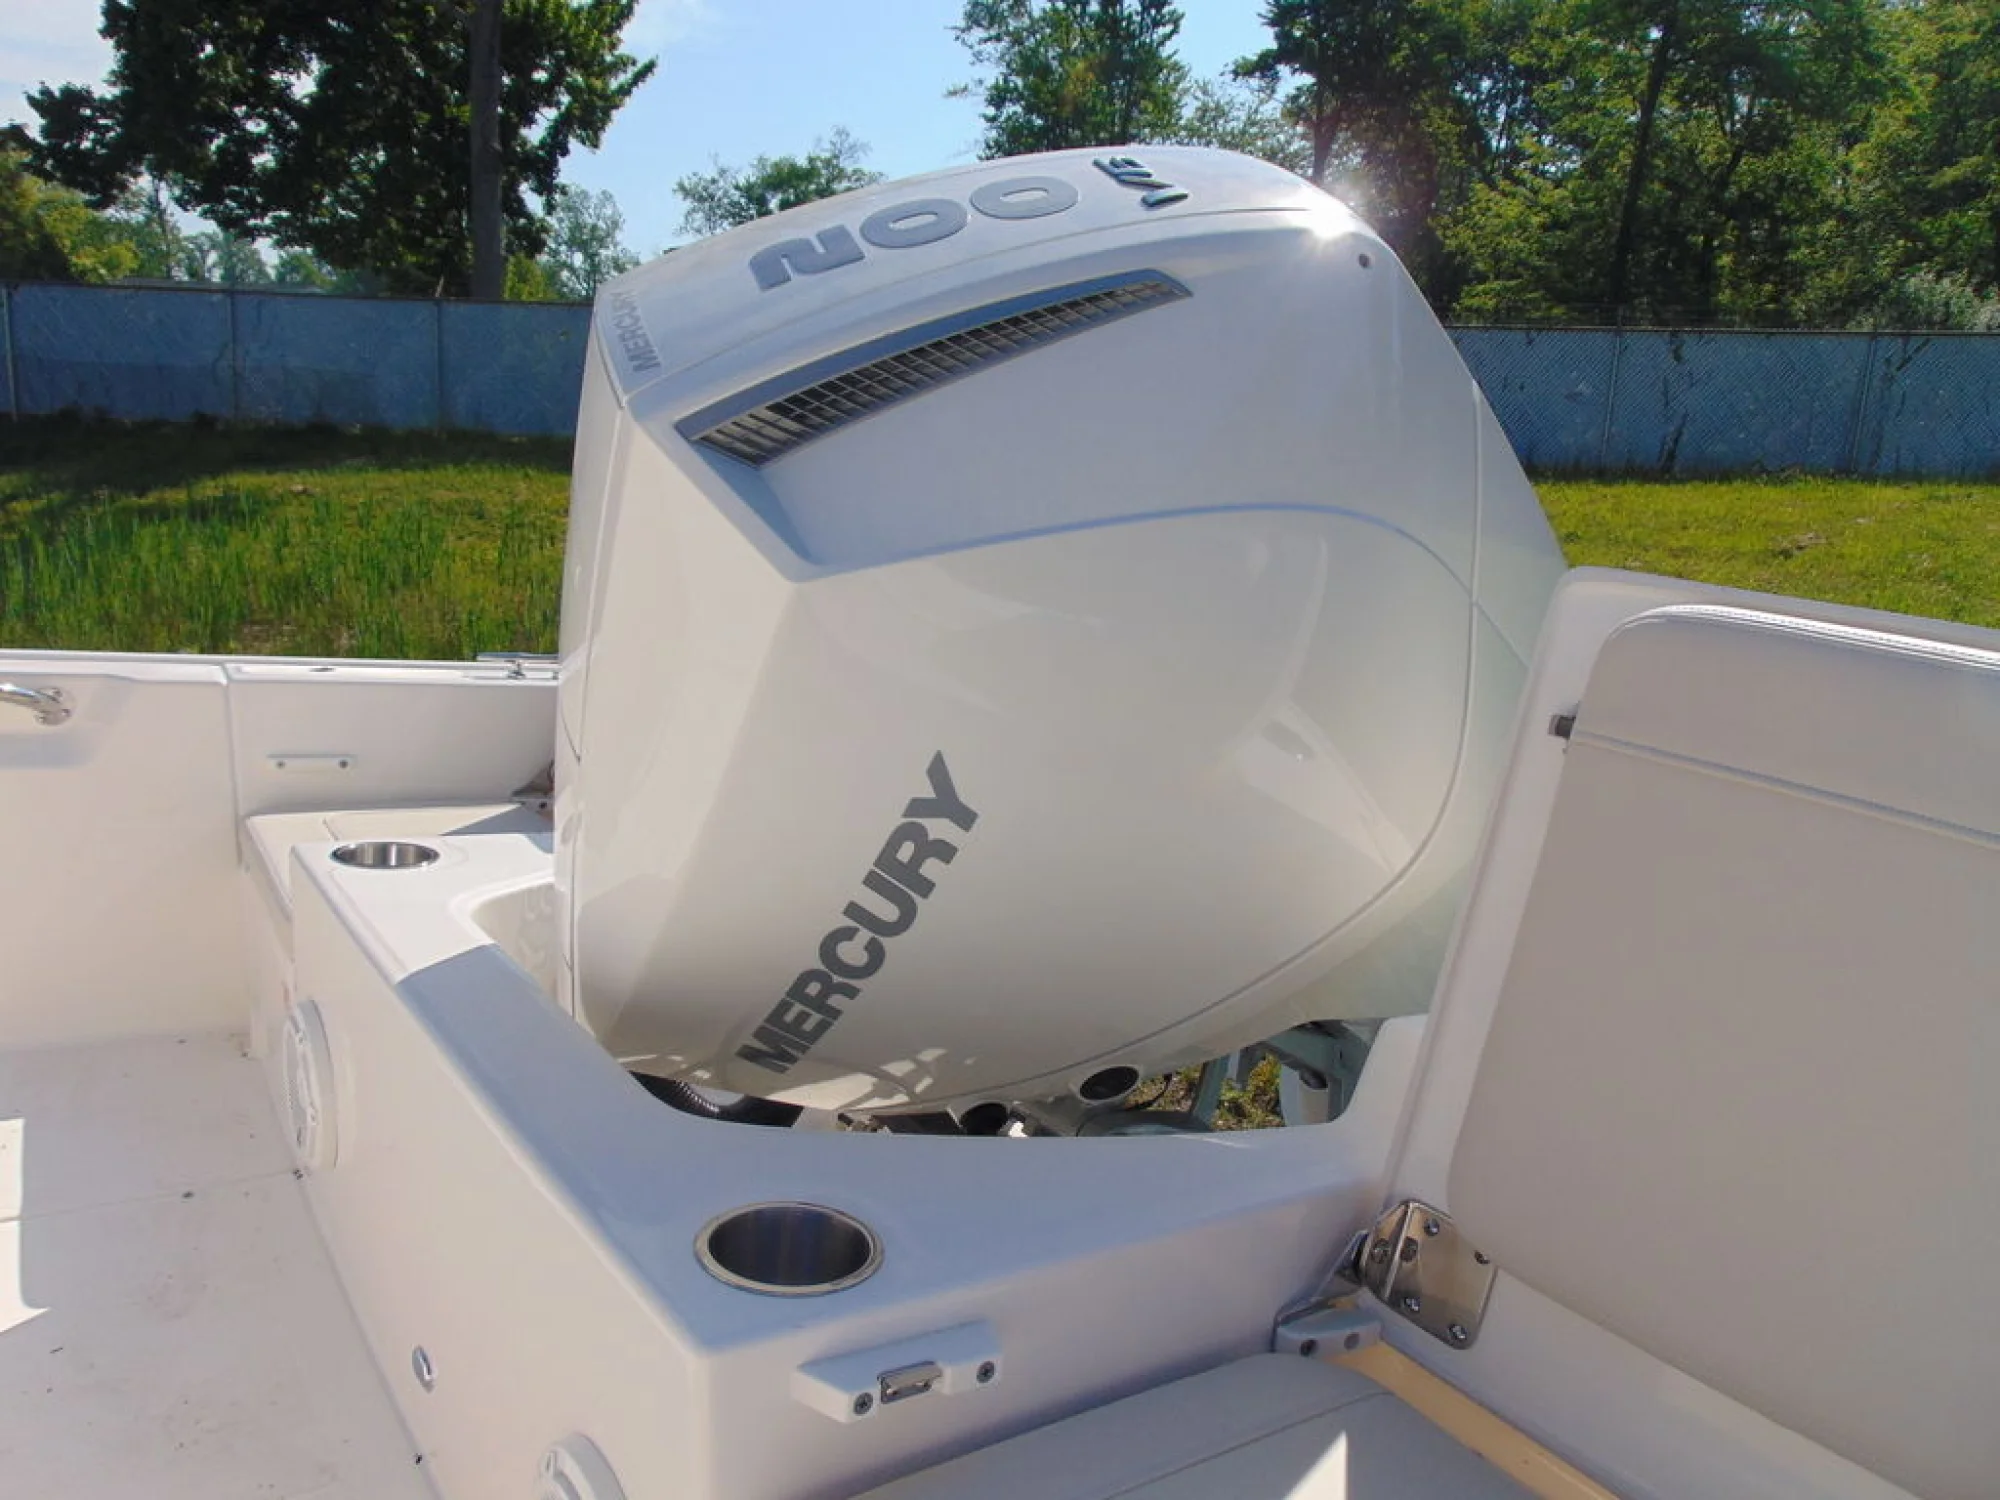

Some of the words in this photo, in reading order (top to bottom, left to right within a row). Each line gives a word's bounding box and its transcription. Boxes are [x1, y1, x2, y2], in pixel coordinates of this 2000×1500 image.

[748, 174, 1079, 292] 200
[610, 290, 662, 372] MERCURY
[735, 750, 979, 1075] MERCURY
